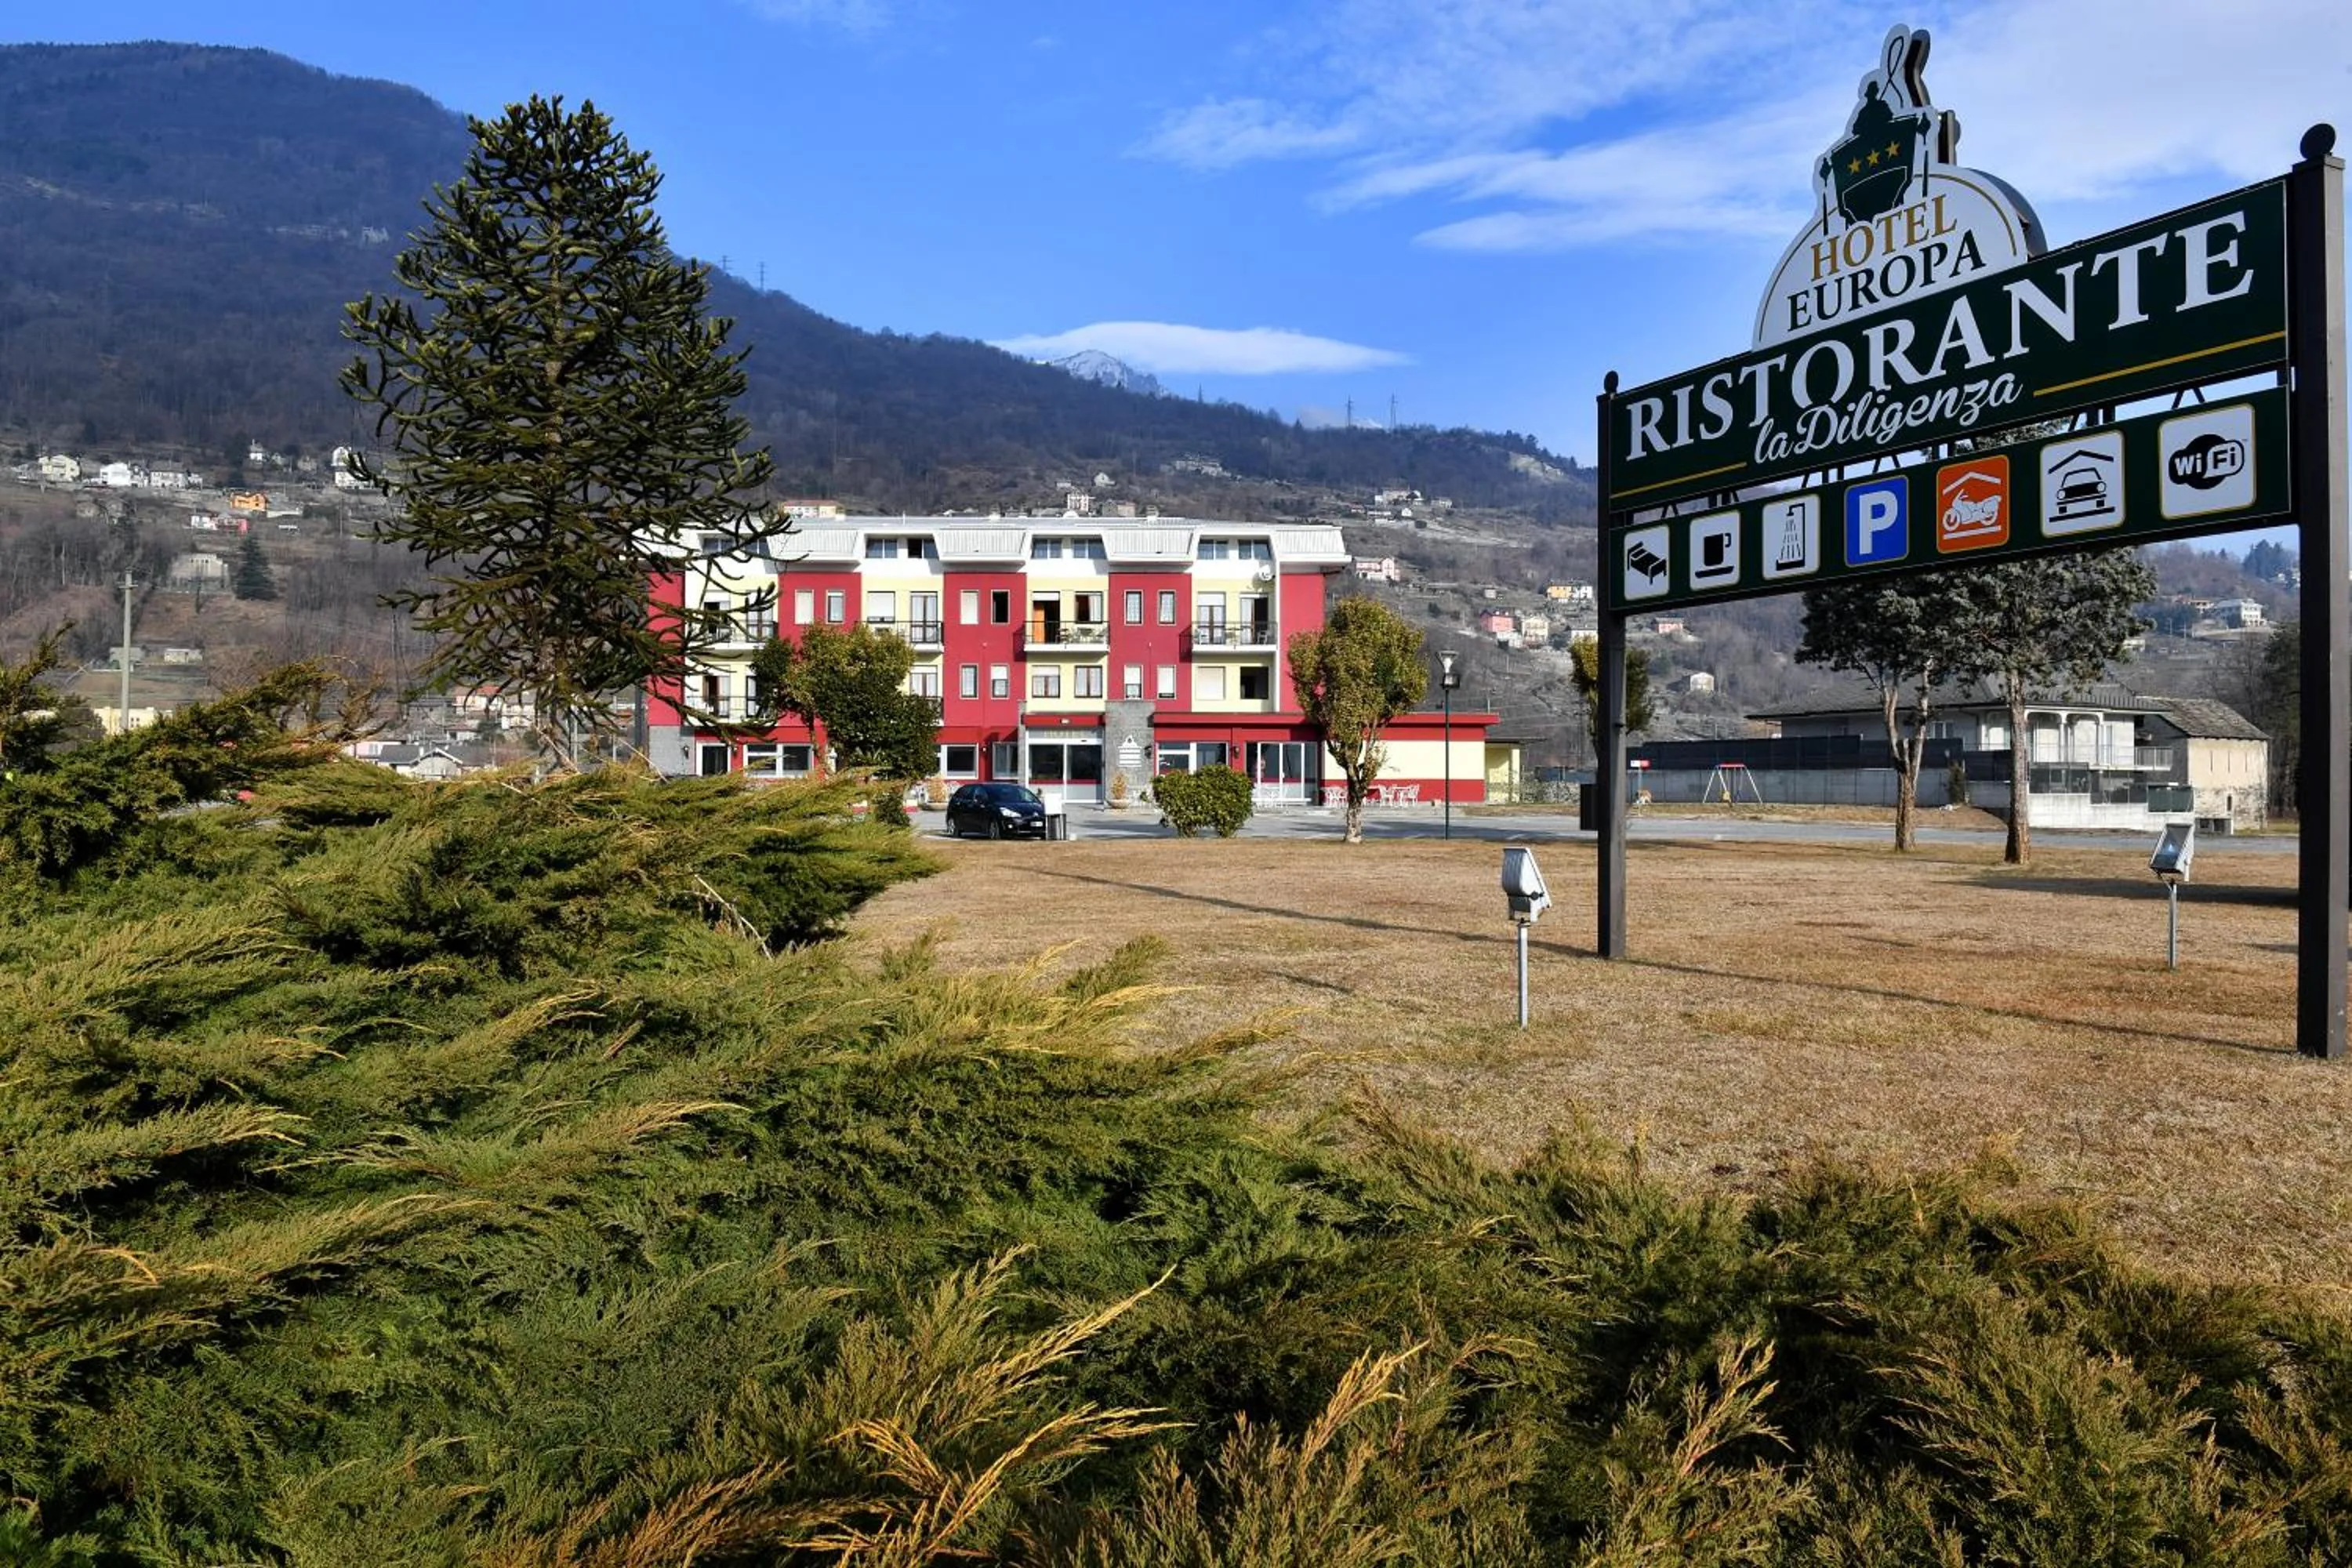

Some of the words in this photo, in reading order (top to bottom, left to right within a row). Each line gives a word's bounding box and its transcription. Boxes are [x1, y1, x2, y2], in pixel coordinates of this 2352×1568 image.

[1787, 229, 1987, 332] EUROPA
[1811, 194, 1957, 281] HOTEL
[1625, 211, 2254, 463] RISTORANTE
[1754, 418, 1795, 464] la
[1792, 372, 2023, 455] Diligenza
[1859, 491, 1898, 555] P
